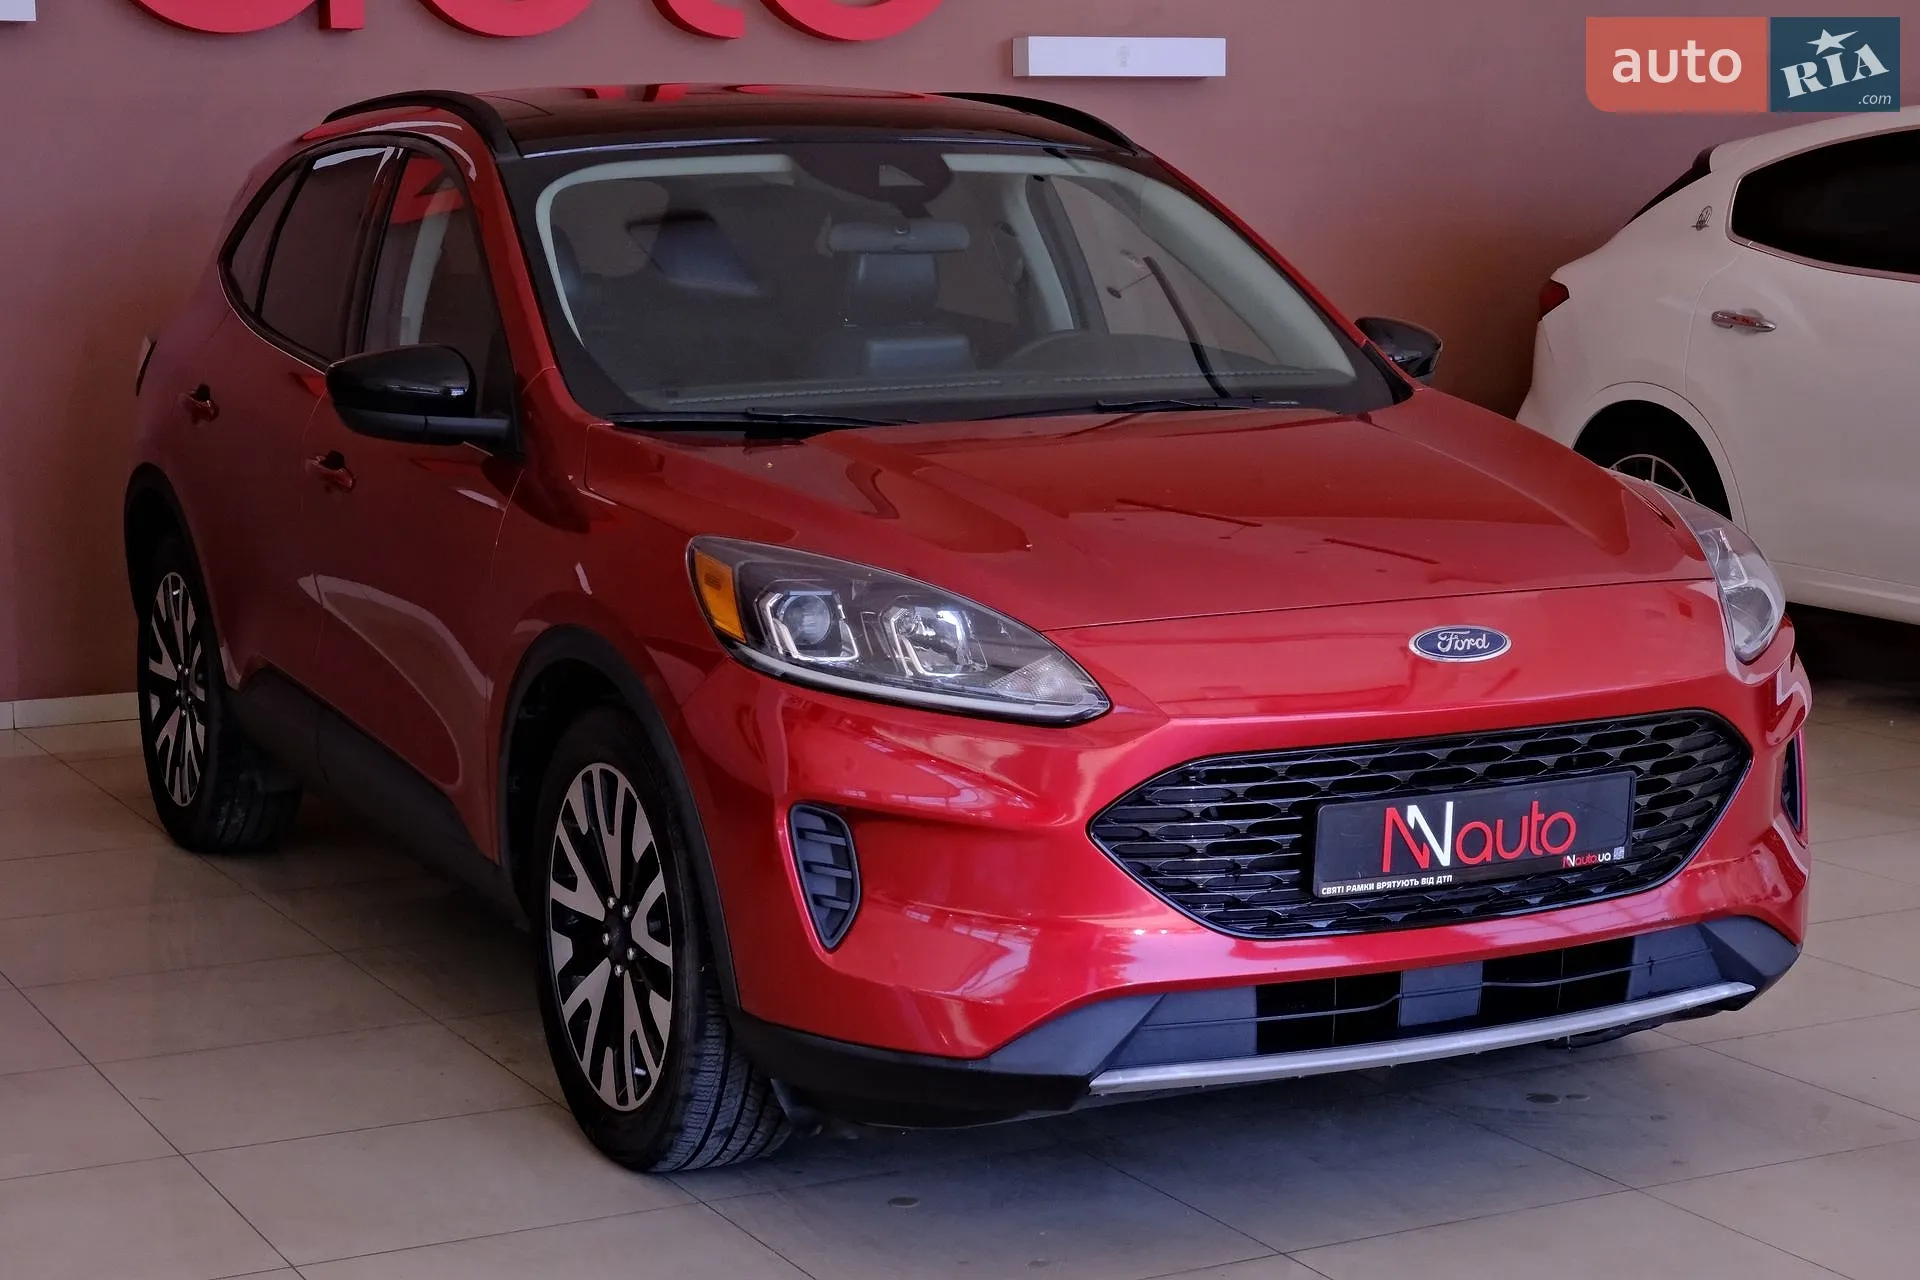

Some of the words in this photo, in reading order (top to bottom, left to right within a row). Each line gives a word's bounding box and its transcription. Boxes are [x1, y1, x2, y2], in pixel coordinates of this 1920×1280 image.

[1437, 631, 1490, 652] Ford
[1321, 886, 1344, 895] СВЯТІ
[1345, 882, 1375, 893] РАМКИ
[1376, 878, 1419, 890] ВРЯТУЮТЬ
[1421, 876, 1434, 886] ВІД
[1436, 874, 1453, 885] ДТП
